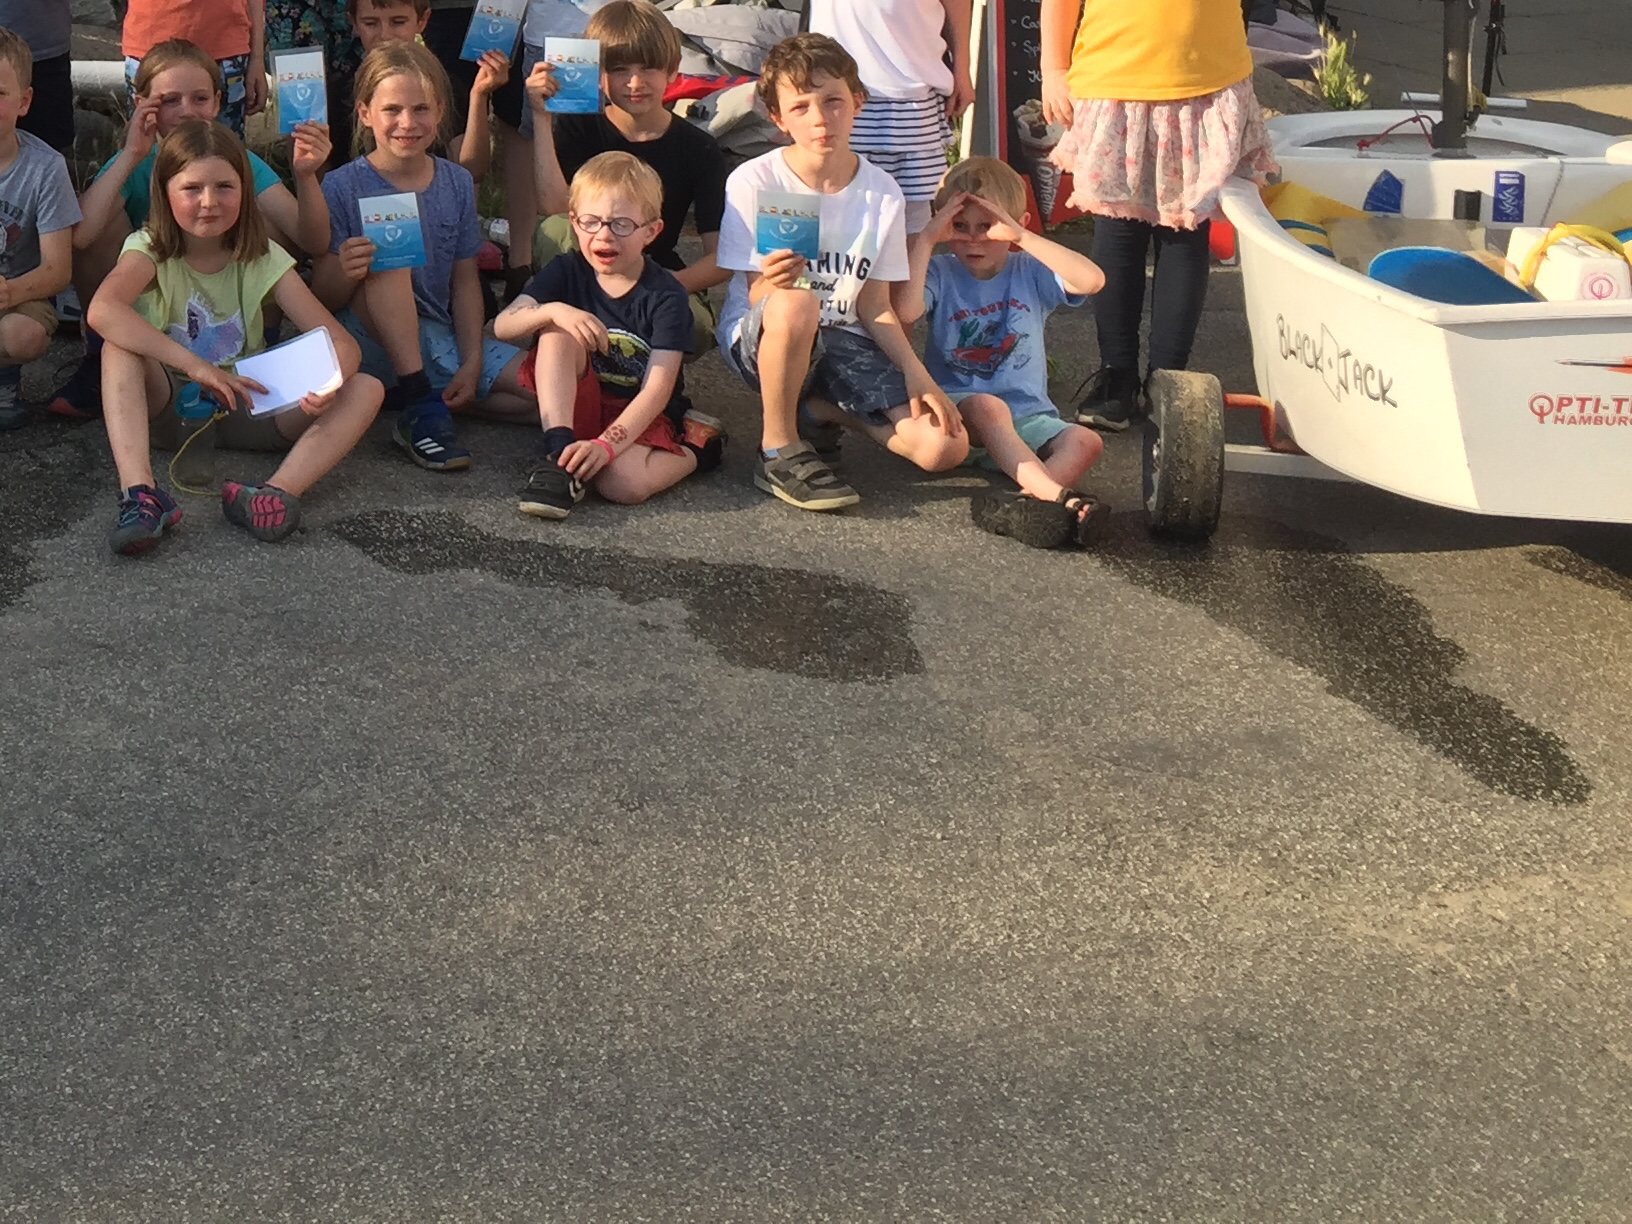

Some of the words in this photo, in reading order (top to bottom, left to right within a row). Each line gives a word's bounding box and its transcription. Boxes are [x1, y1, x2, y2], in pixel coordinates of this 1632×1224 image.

[810, 278, 839, 292] and
[1276, 313, 1324, 374] BLACK
[1338, 348, 1398, 408] JACK
[1553, 413, 1632, 427] HAMBUR
